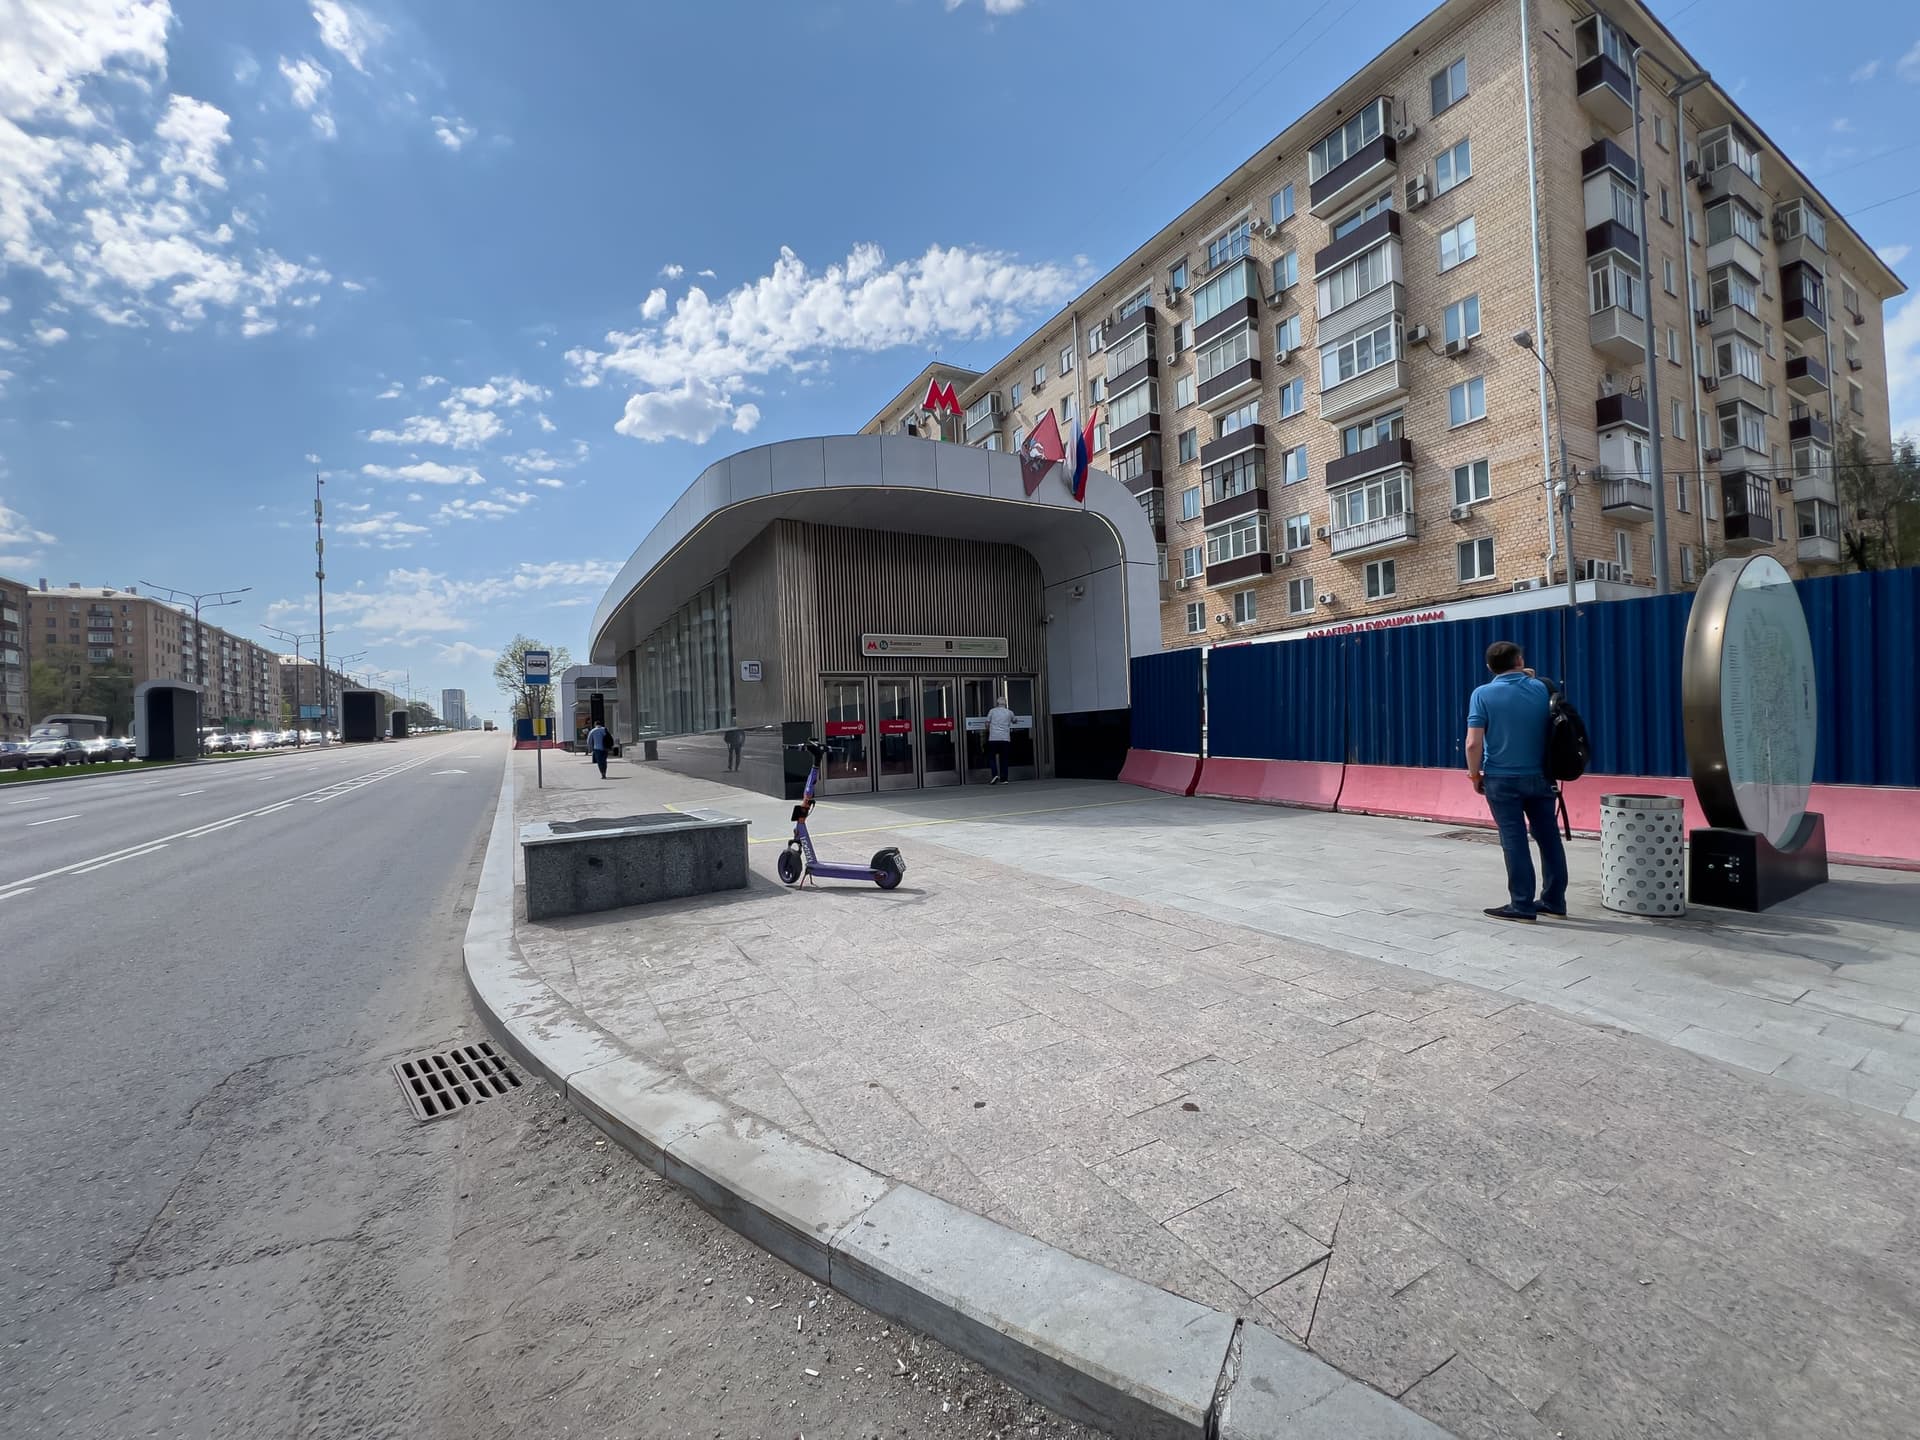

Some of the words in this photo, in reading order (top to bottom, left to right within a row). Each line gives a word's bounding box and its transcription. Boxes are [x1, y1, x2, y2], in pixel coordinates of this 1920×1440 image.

[1326, 624, 1354, 637] ДЕТЕЙ
[1356, 623, 1365, 632] И
[1366, 615, 1414, 631] БУДУЩИХ
[1416, 611, 1445, 623] МАМ
